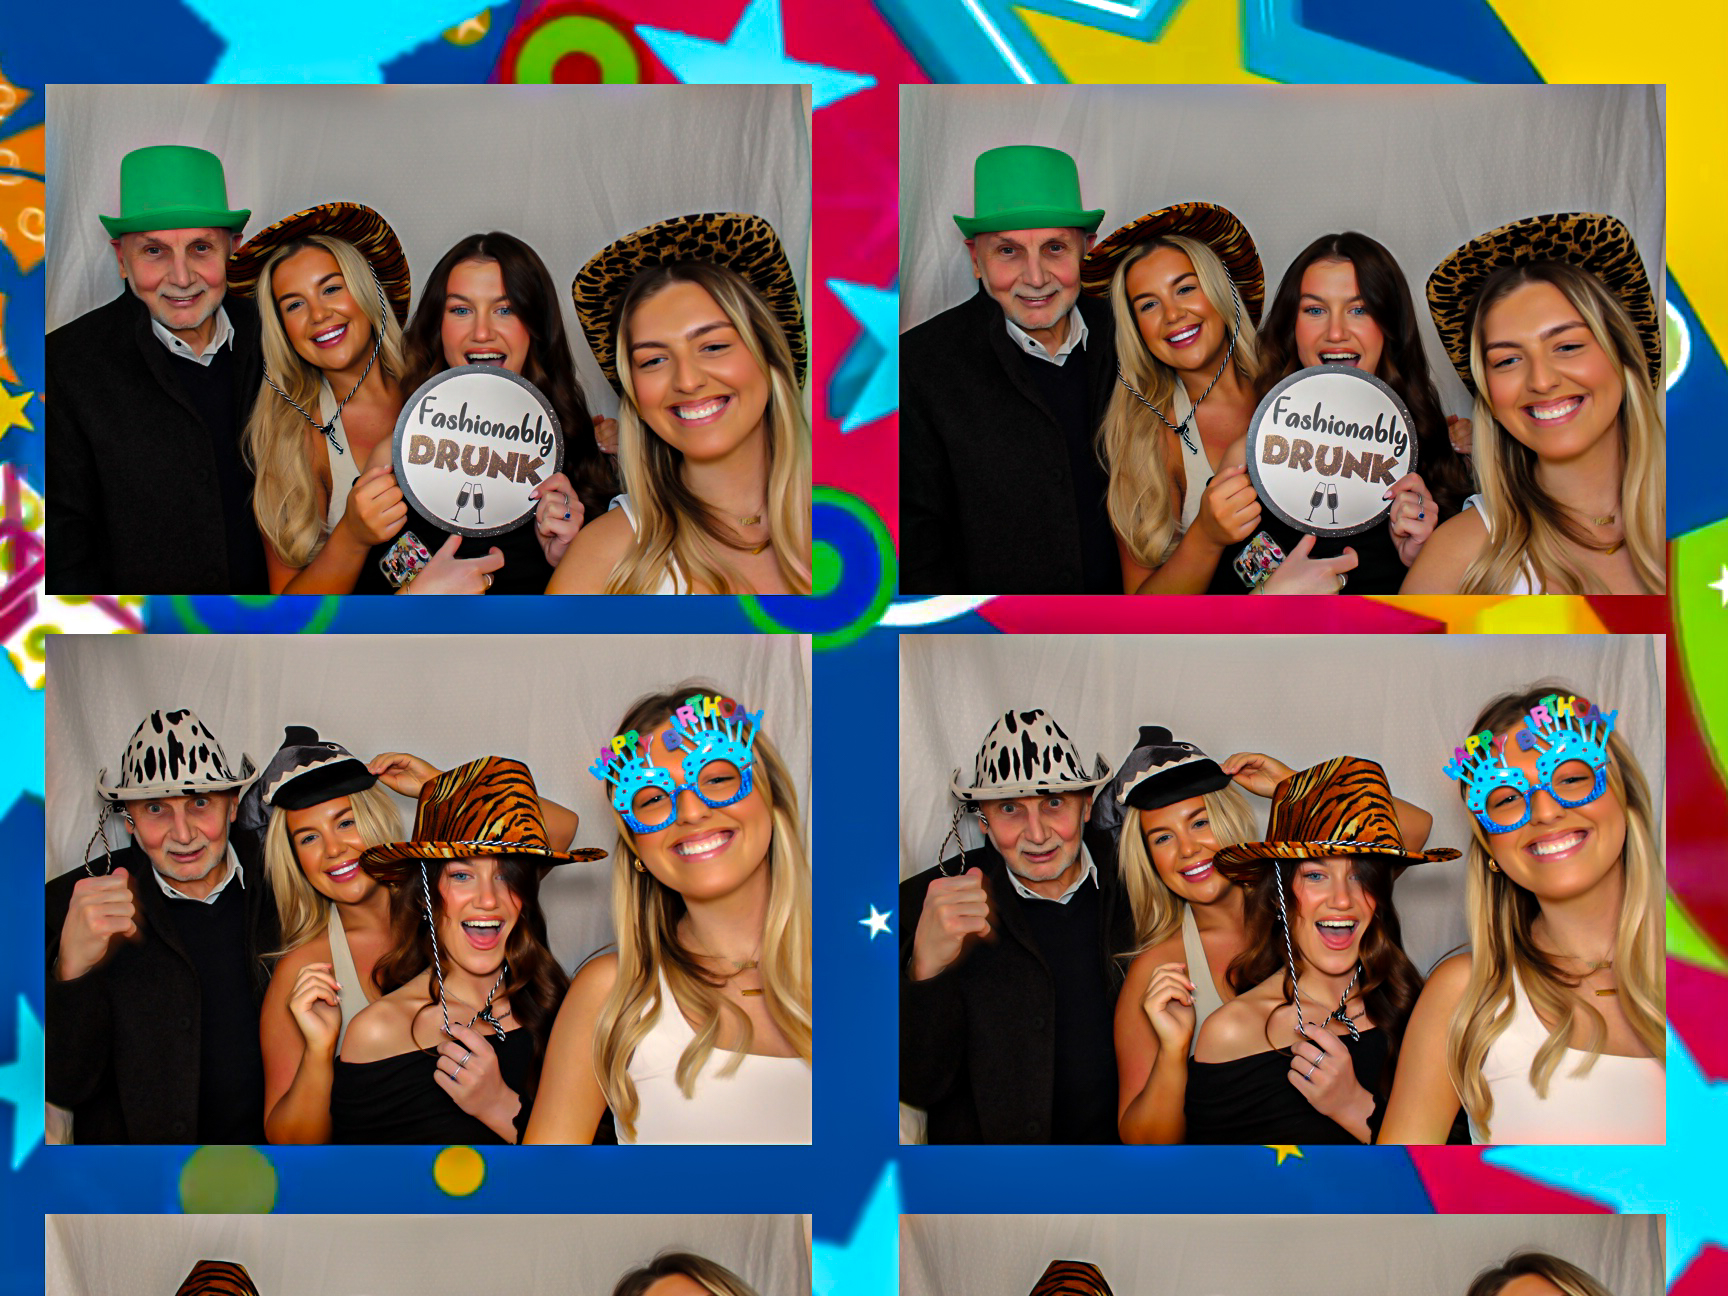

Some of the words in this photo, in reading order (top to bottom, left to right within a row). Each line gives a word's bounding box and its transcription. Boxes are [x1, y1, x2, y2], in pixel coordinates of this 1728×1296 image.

[419, 396, 553, 457] Fashionably
[1273, 396, 1407, 457] Fashionably
[408, 434, 545, 486] DRUNK
[1262, 434, 1399, 486] DRUNK
